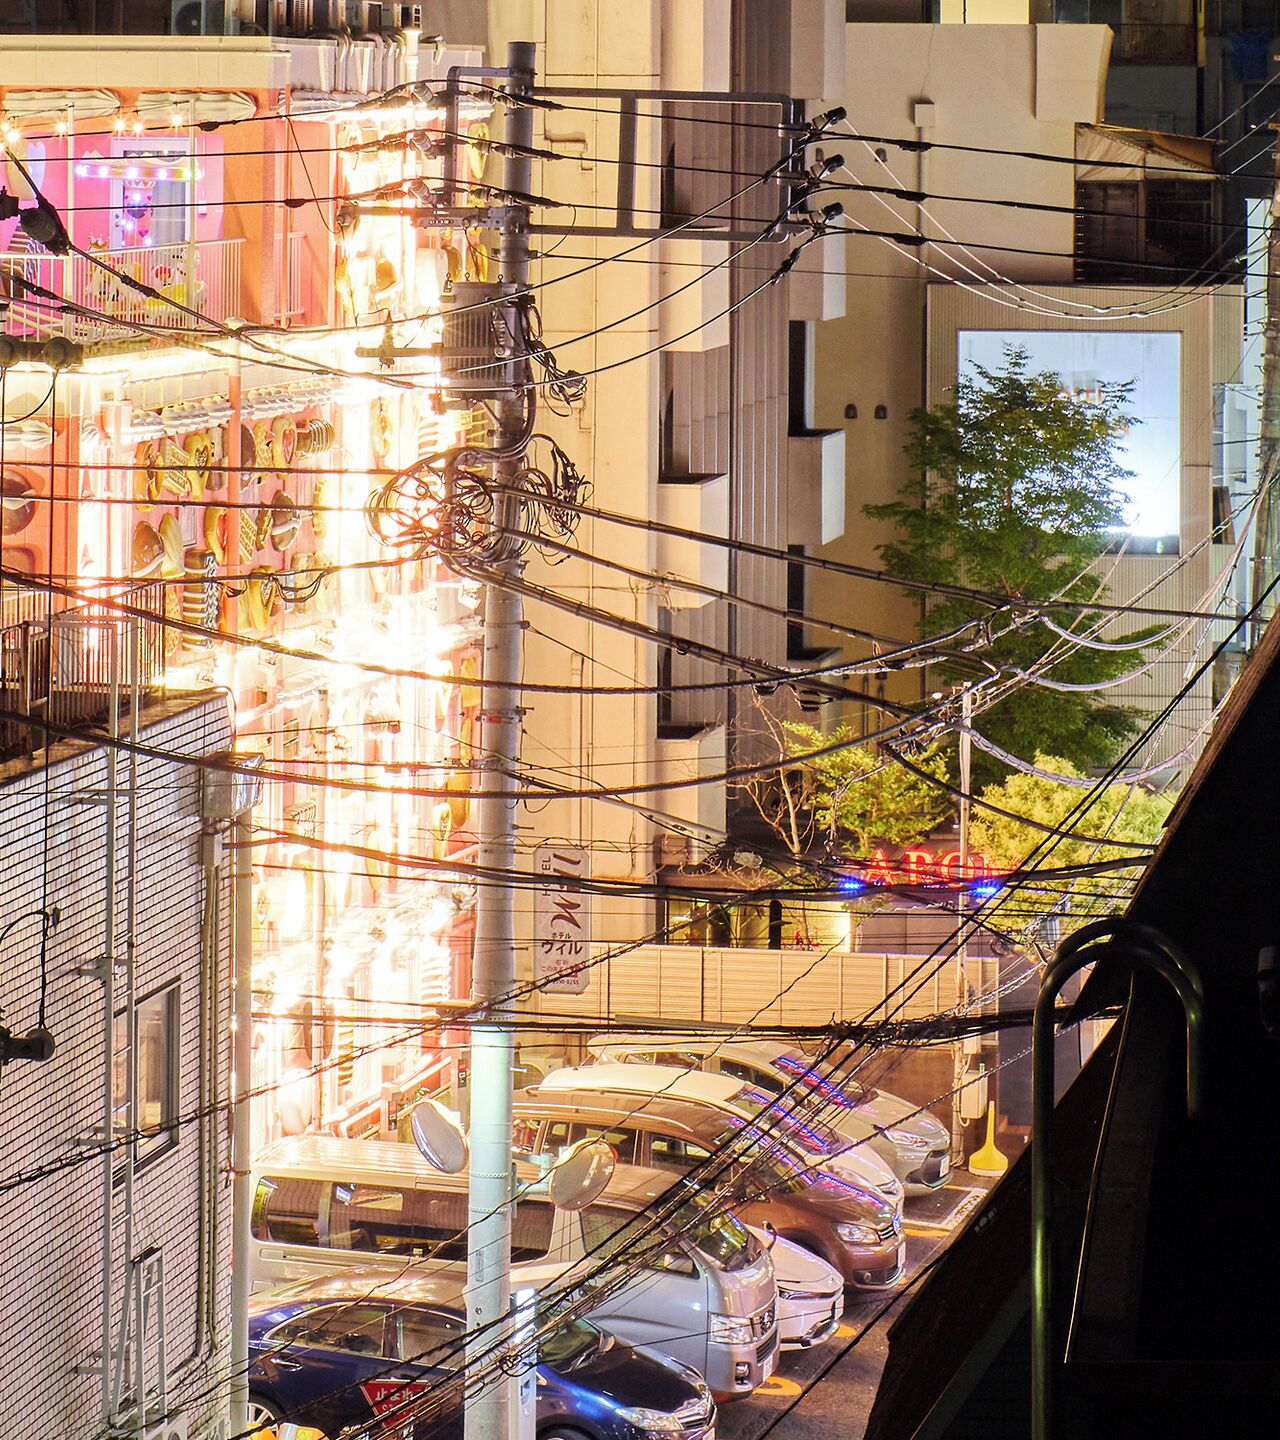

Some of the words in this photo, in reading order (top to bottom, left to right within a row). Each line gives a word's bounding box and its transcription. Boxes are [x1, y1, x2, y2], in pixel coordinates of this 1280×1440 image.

[541, 856, 551, 897] HOEL
[551, 931, 573, 940] ホテル
[541, 940, 583, 955] ウィル
